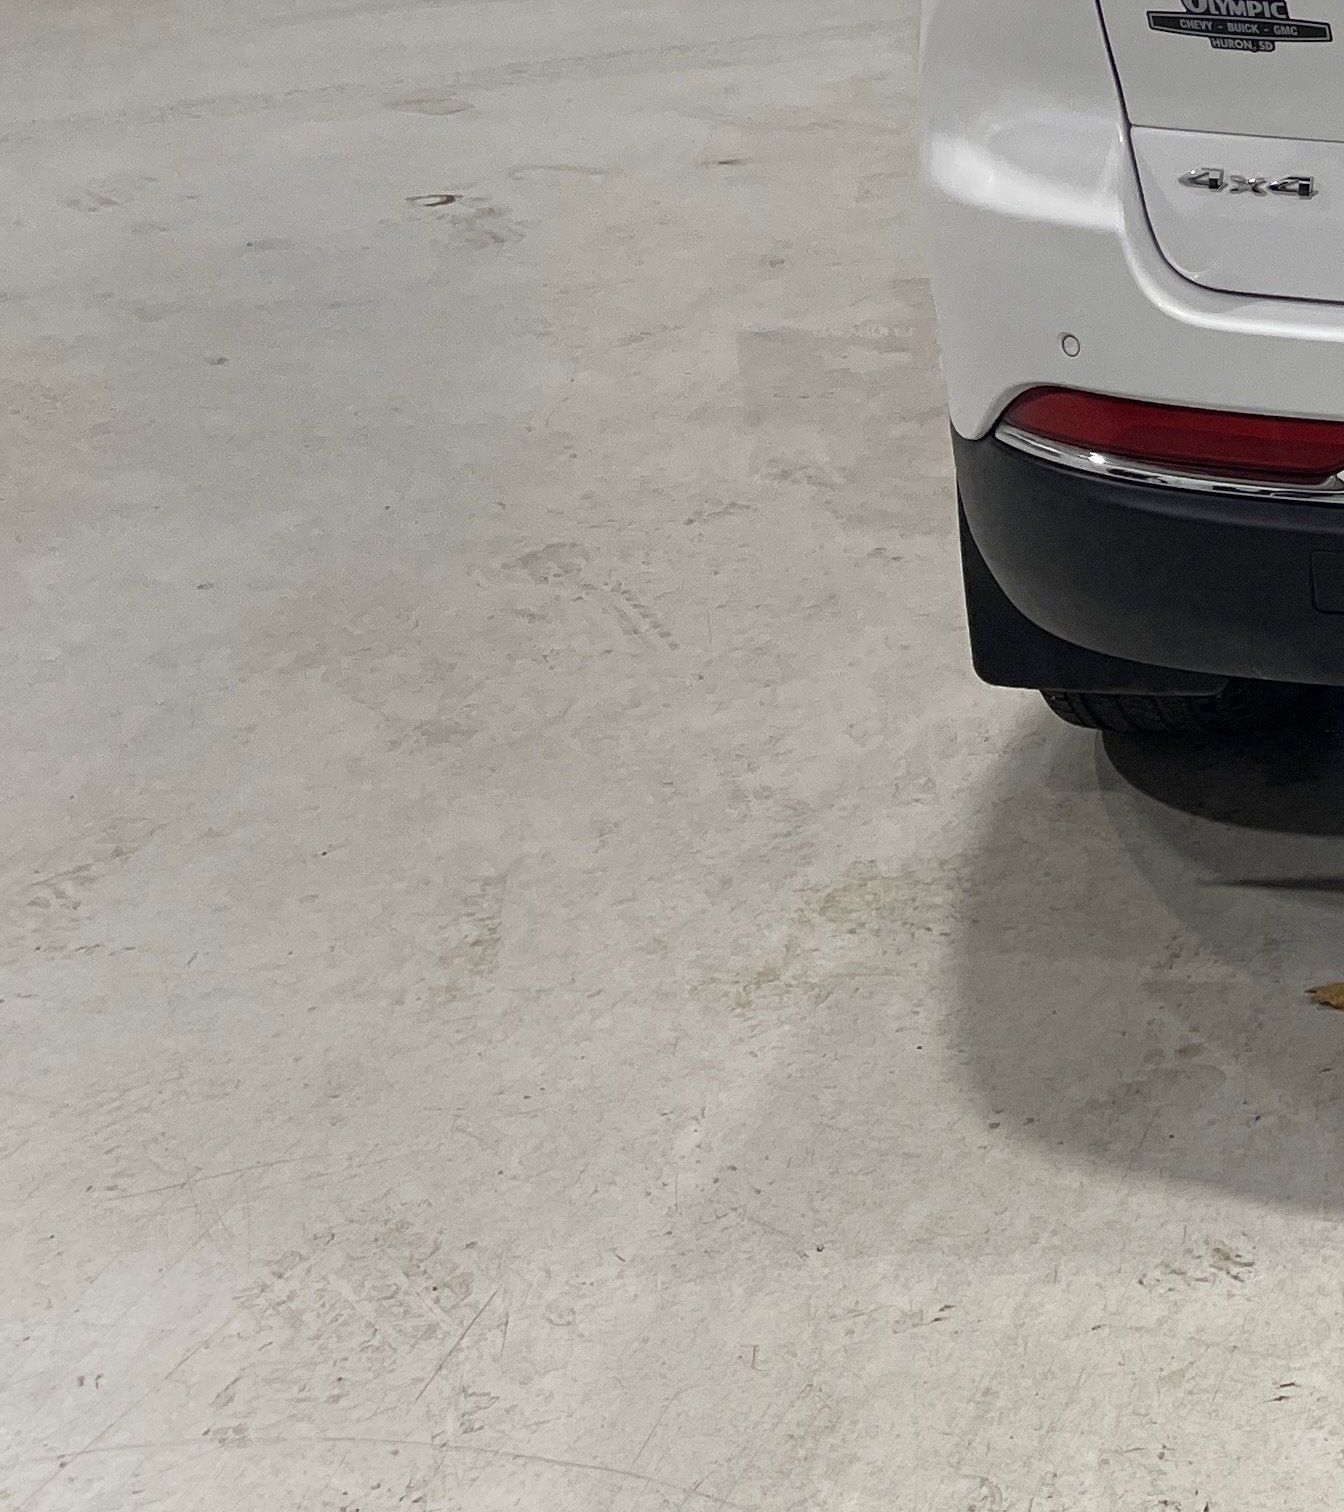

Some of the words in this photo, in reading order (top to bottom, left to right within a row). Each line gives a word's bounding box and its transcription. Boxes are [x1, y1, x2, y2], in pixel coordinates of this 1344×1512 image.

[1179, 19, 1213, 31] CHEVY
[1227, 22, 1260, 34] BUICK
[1273, 25, 1298, 36] GMC
[1258, 39, 1274, 51] SD
[1177, 168, 1319, 200] 4x4
